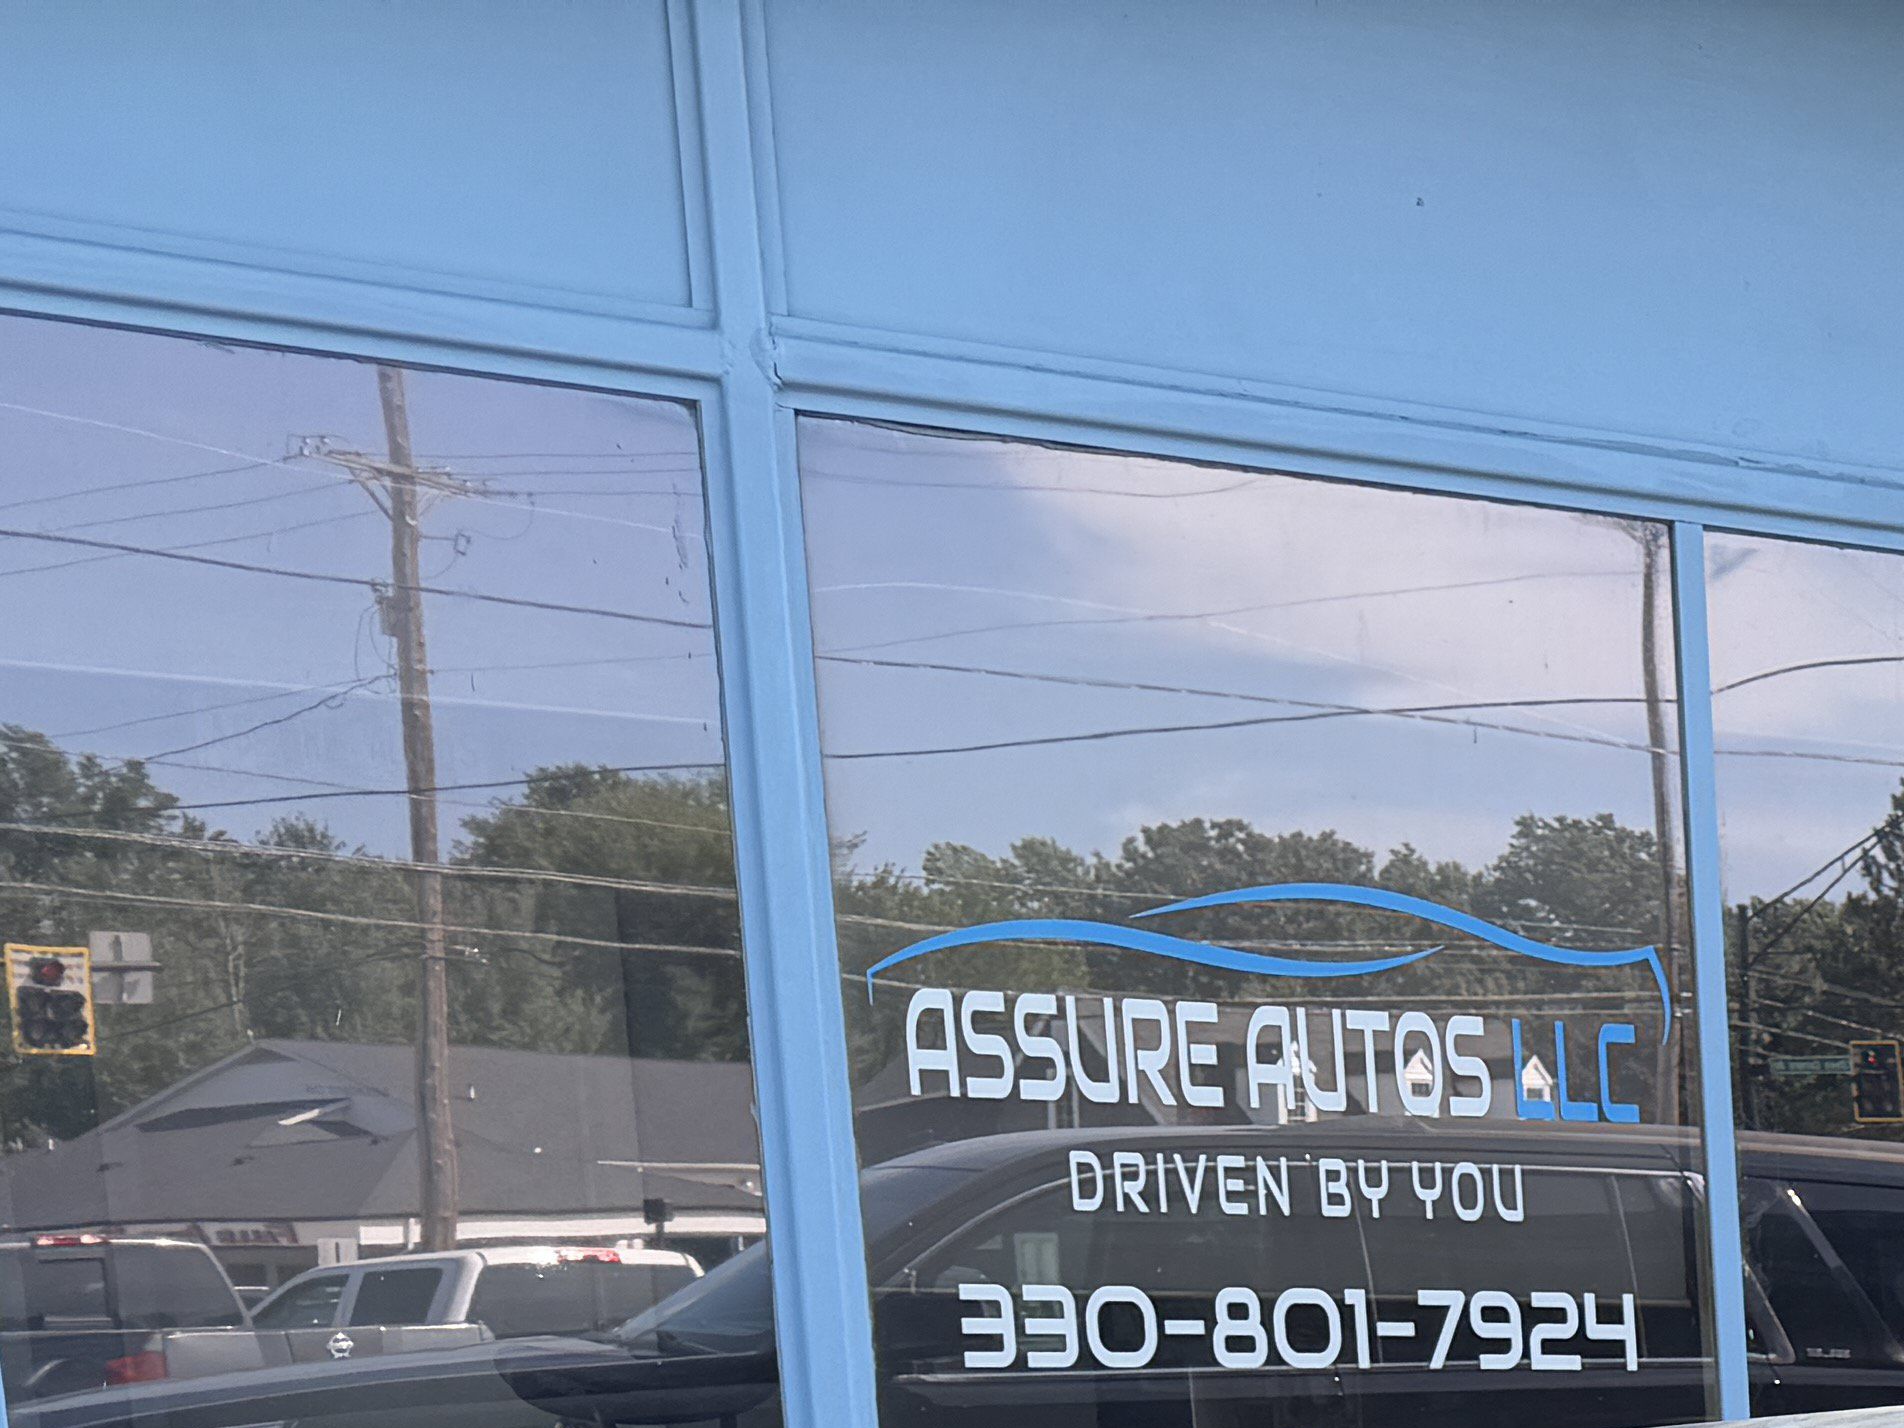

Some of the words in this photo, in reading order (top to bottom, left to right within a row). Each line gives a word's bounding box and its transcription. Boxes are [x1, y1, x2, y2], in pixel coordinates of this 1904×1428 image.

[906, 988, 1225, 1108] ASSURE
[1248, 1005, 1493, 1118] AUTOS
[1511, 1018, 1640, 1123] LLC
[1067, 1149, 1292, 1217] DRIVEN
[1319, 1157, 1389, 1220] BY
[1411, 1161, 1527, 1223] YOU
[957, 1283, 1639, 1372] 330-801-7924
